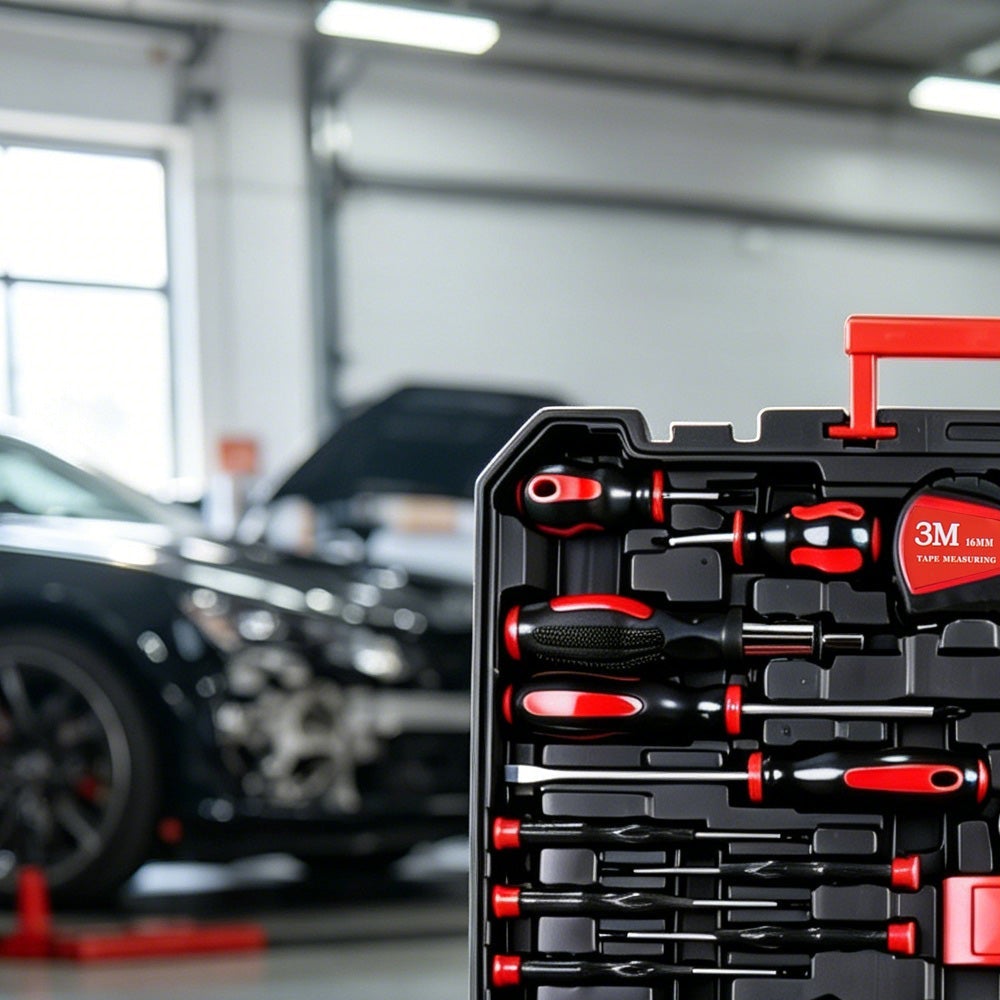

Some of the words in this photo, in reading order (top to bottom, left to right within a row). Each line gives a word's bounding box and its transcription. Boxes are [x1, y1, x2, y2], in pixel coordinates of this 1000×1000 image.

[914, 521, 960, 547] 3M
[965, 537, 994, 547] 16MM
[916, 554, 940, 563] TAPE
[942, 555, 997, 564] MEASURING
